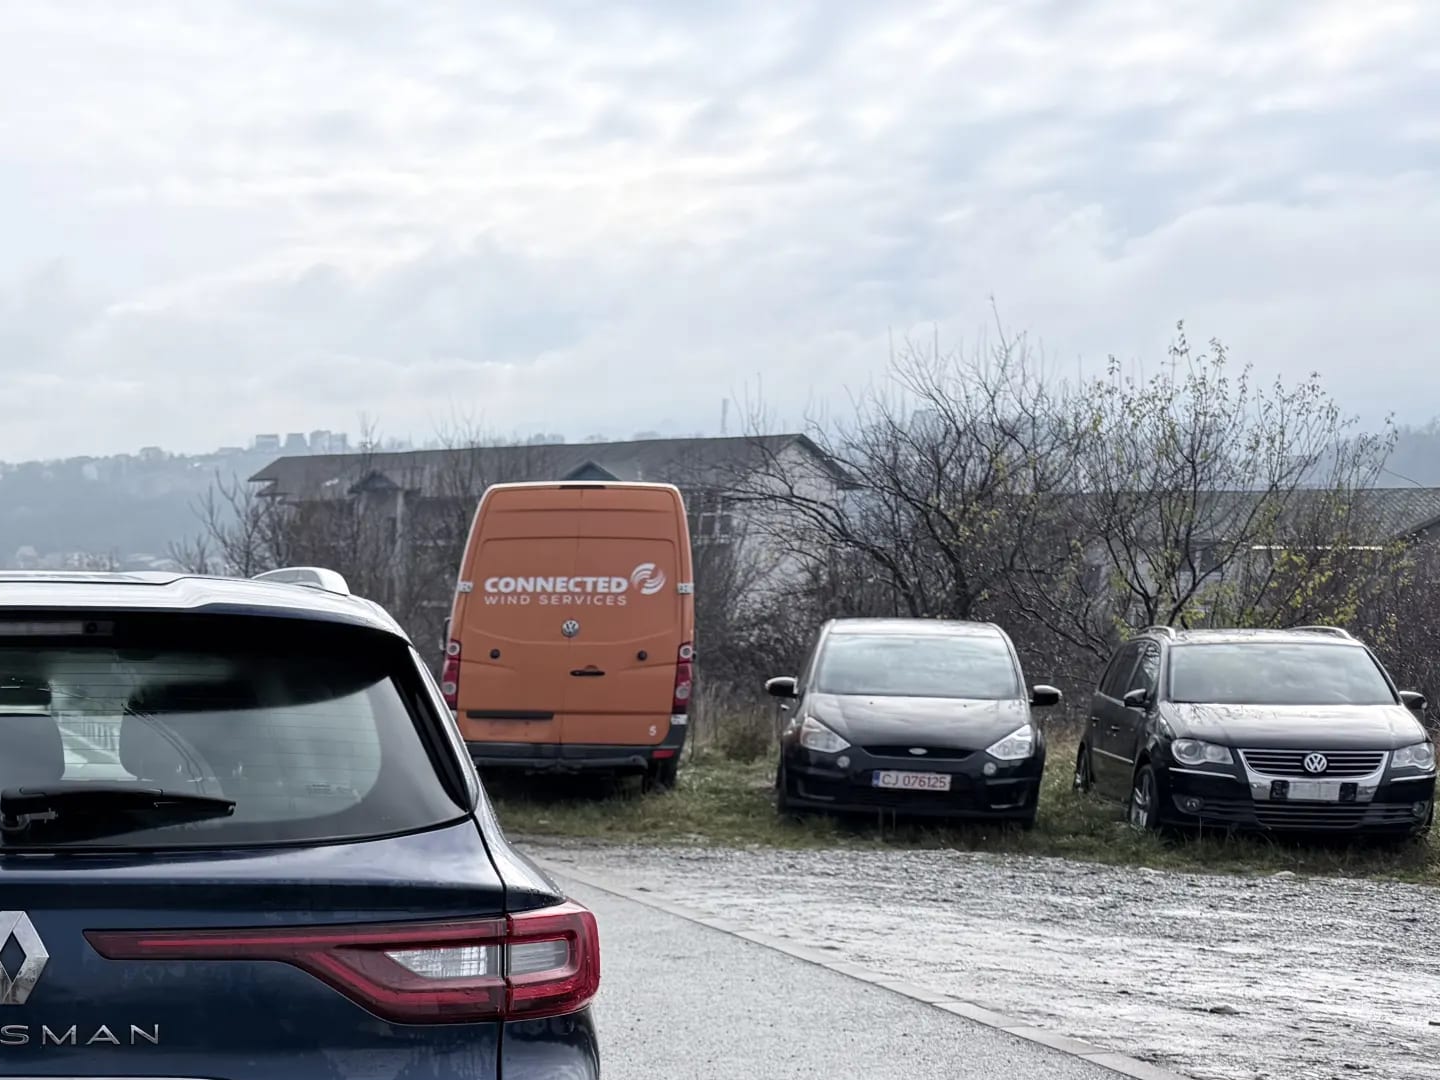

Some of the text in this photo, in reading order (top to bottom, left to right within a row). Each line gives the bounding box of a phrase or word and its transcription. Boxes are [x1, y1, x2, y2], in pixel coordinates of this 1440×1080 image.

[485, 577, 628, 593] CONNECTED
[485, 595, 627, 605] WIND SERVICES
[882, 774, 946, 788] CJ 076125
